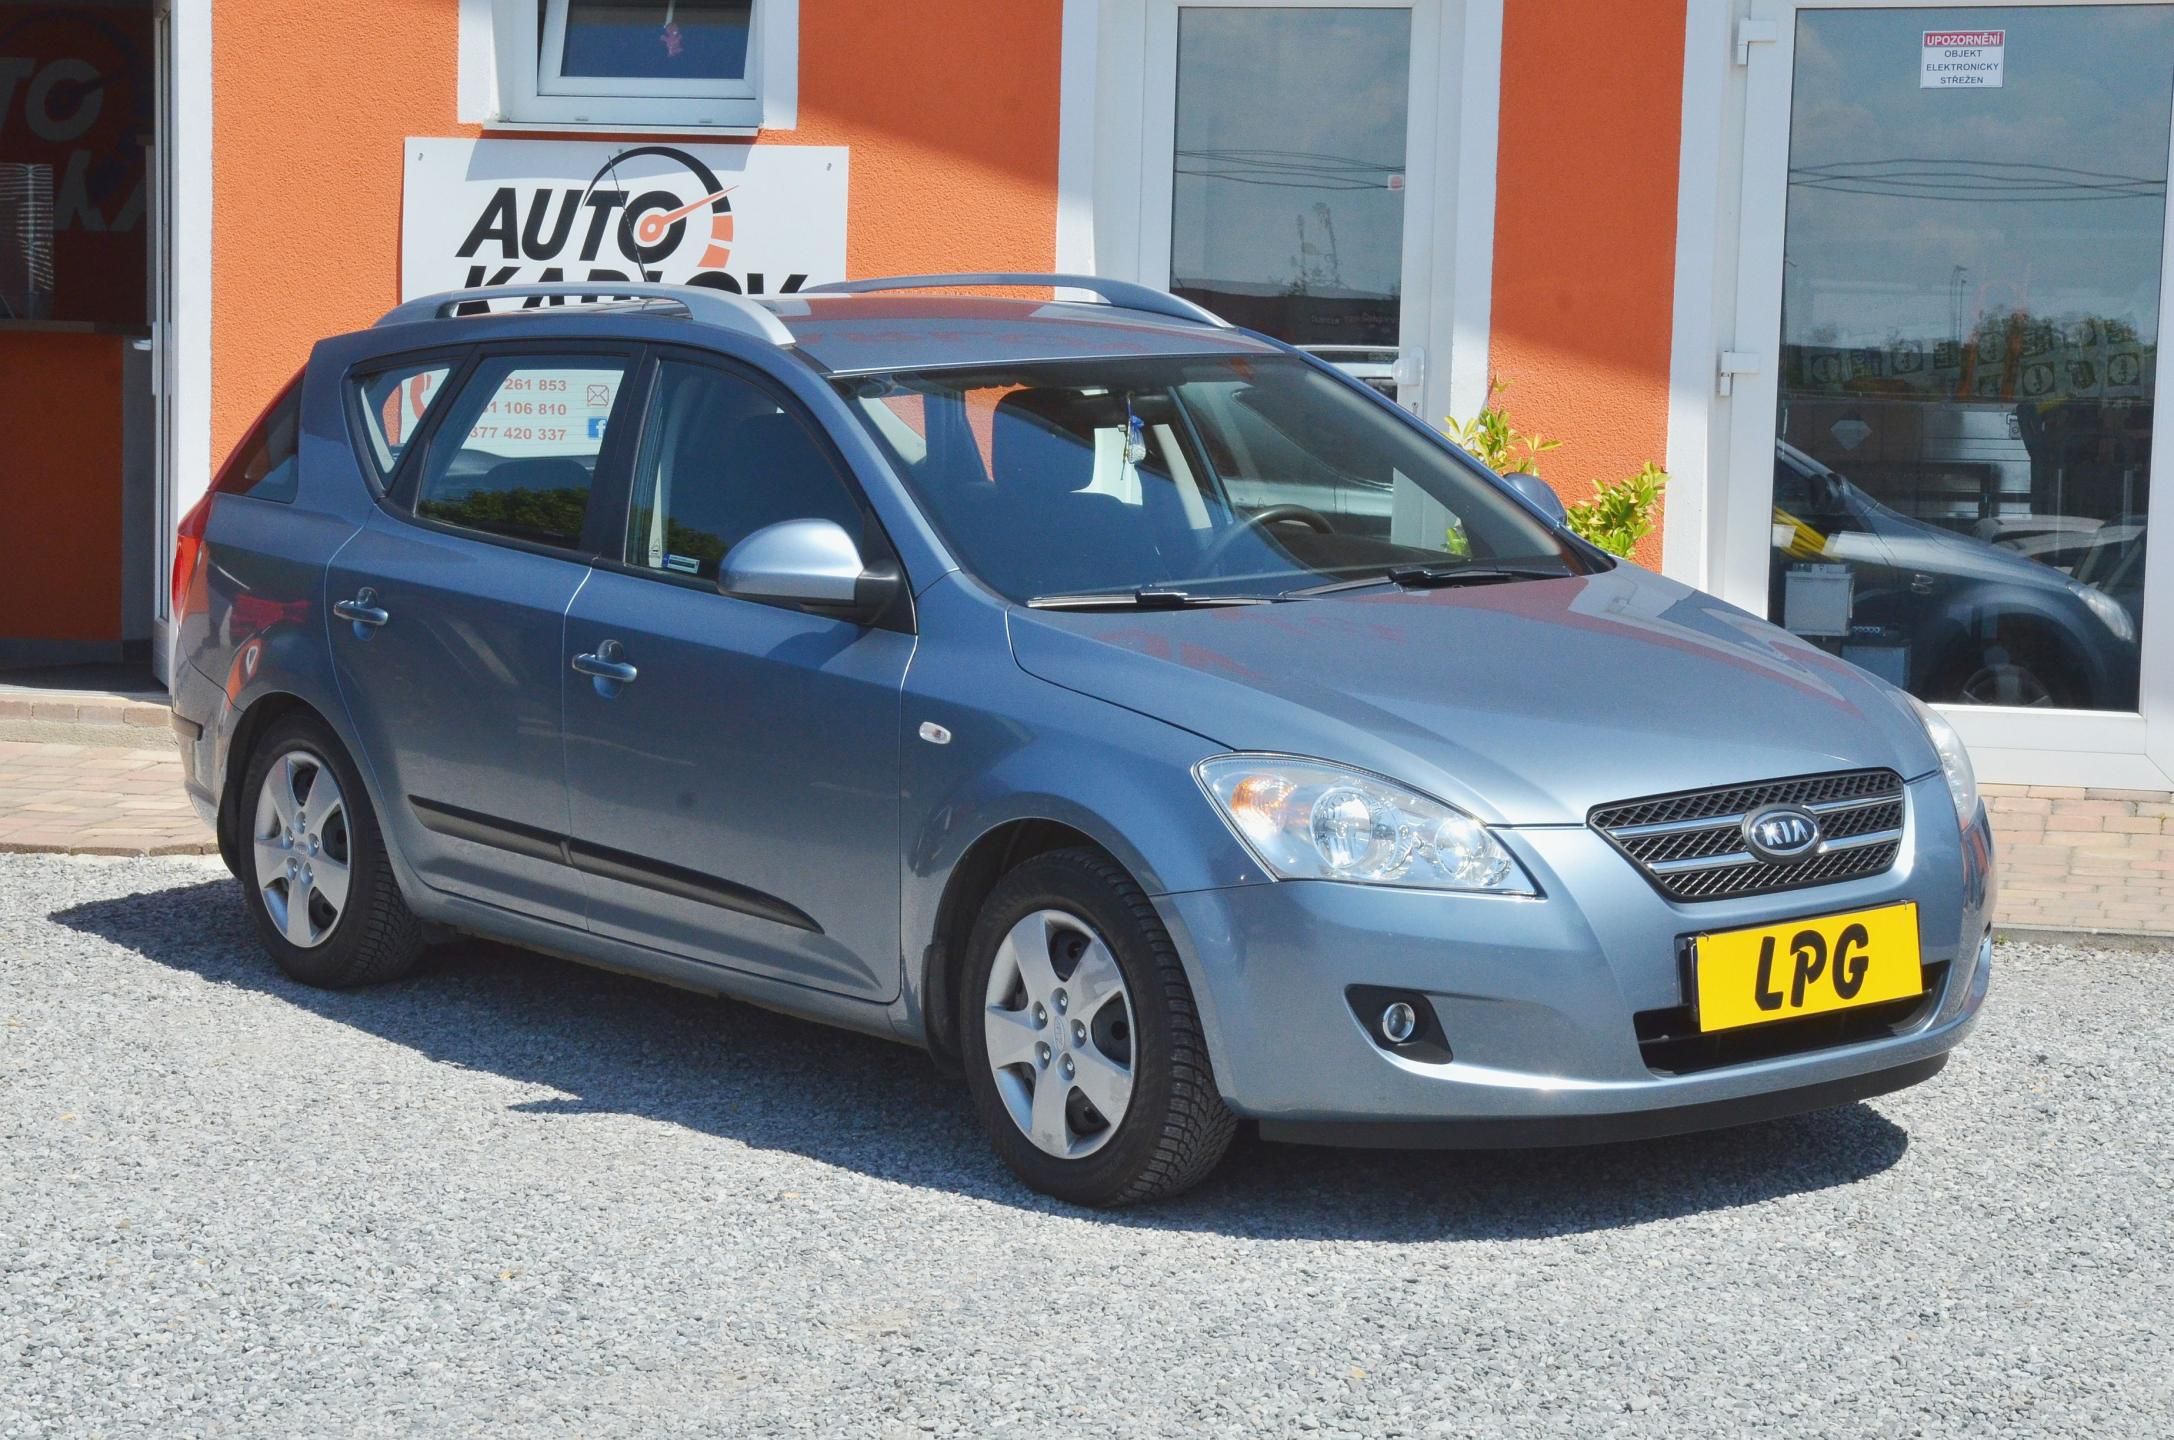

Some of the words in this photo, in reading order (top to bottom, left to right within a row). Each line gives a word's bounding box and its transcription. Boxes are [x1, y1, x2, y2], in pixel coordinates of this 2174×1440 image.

[1926, 32, 2001, 47] UPOZORNĚNÍ
[1944, 49, 1983, 58] OBJEKT
[1926, 63, 1999, 72] ELEKTRONICKY
[1940, 75, 1984, 85] STŘEŽEN
[455, 187, 688, 264] AUTO
[504, 378, 532, 391] 261
[538, 379, 567, 392] 853
[504, 402, 533, 415] 106
[538, 403, 567, 416] 810
[503, 426, 532, 440] 420
[538, 428, 567, 441] 337
[1760, 819, 1809, 846] KIA
[1754, 922, 1870, 1012] LPG
